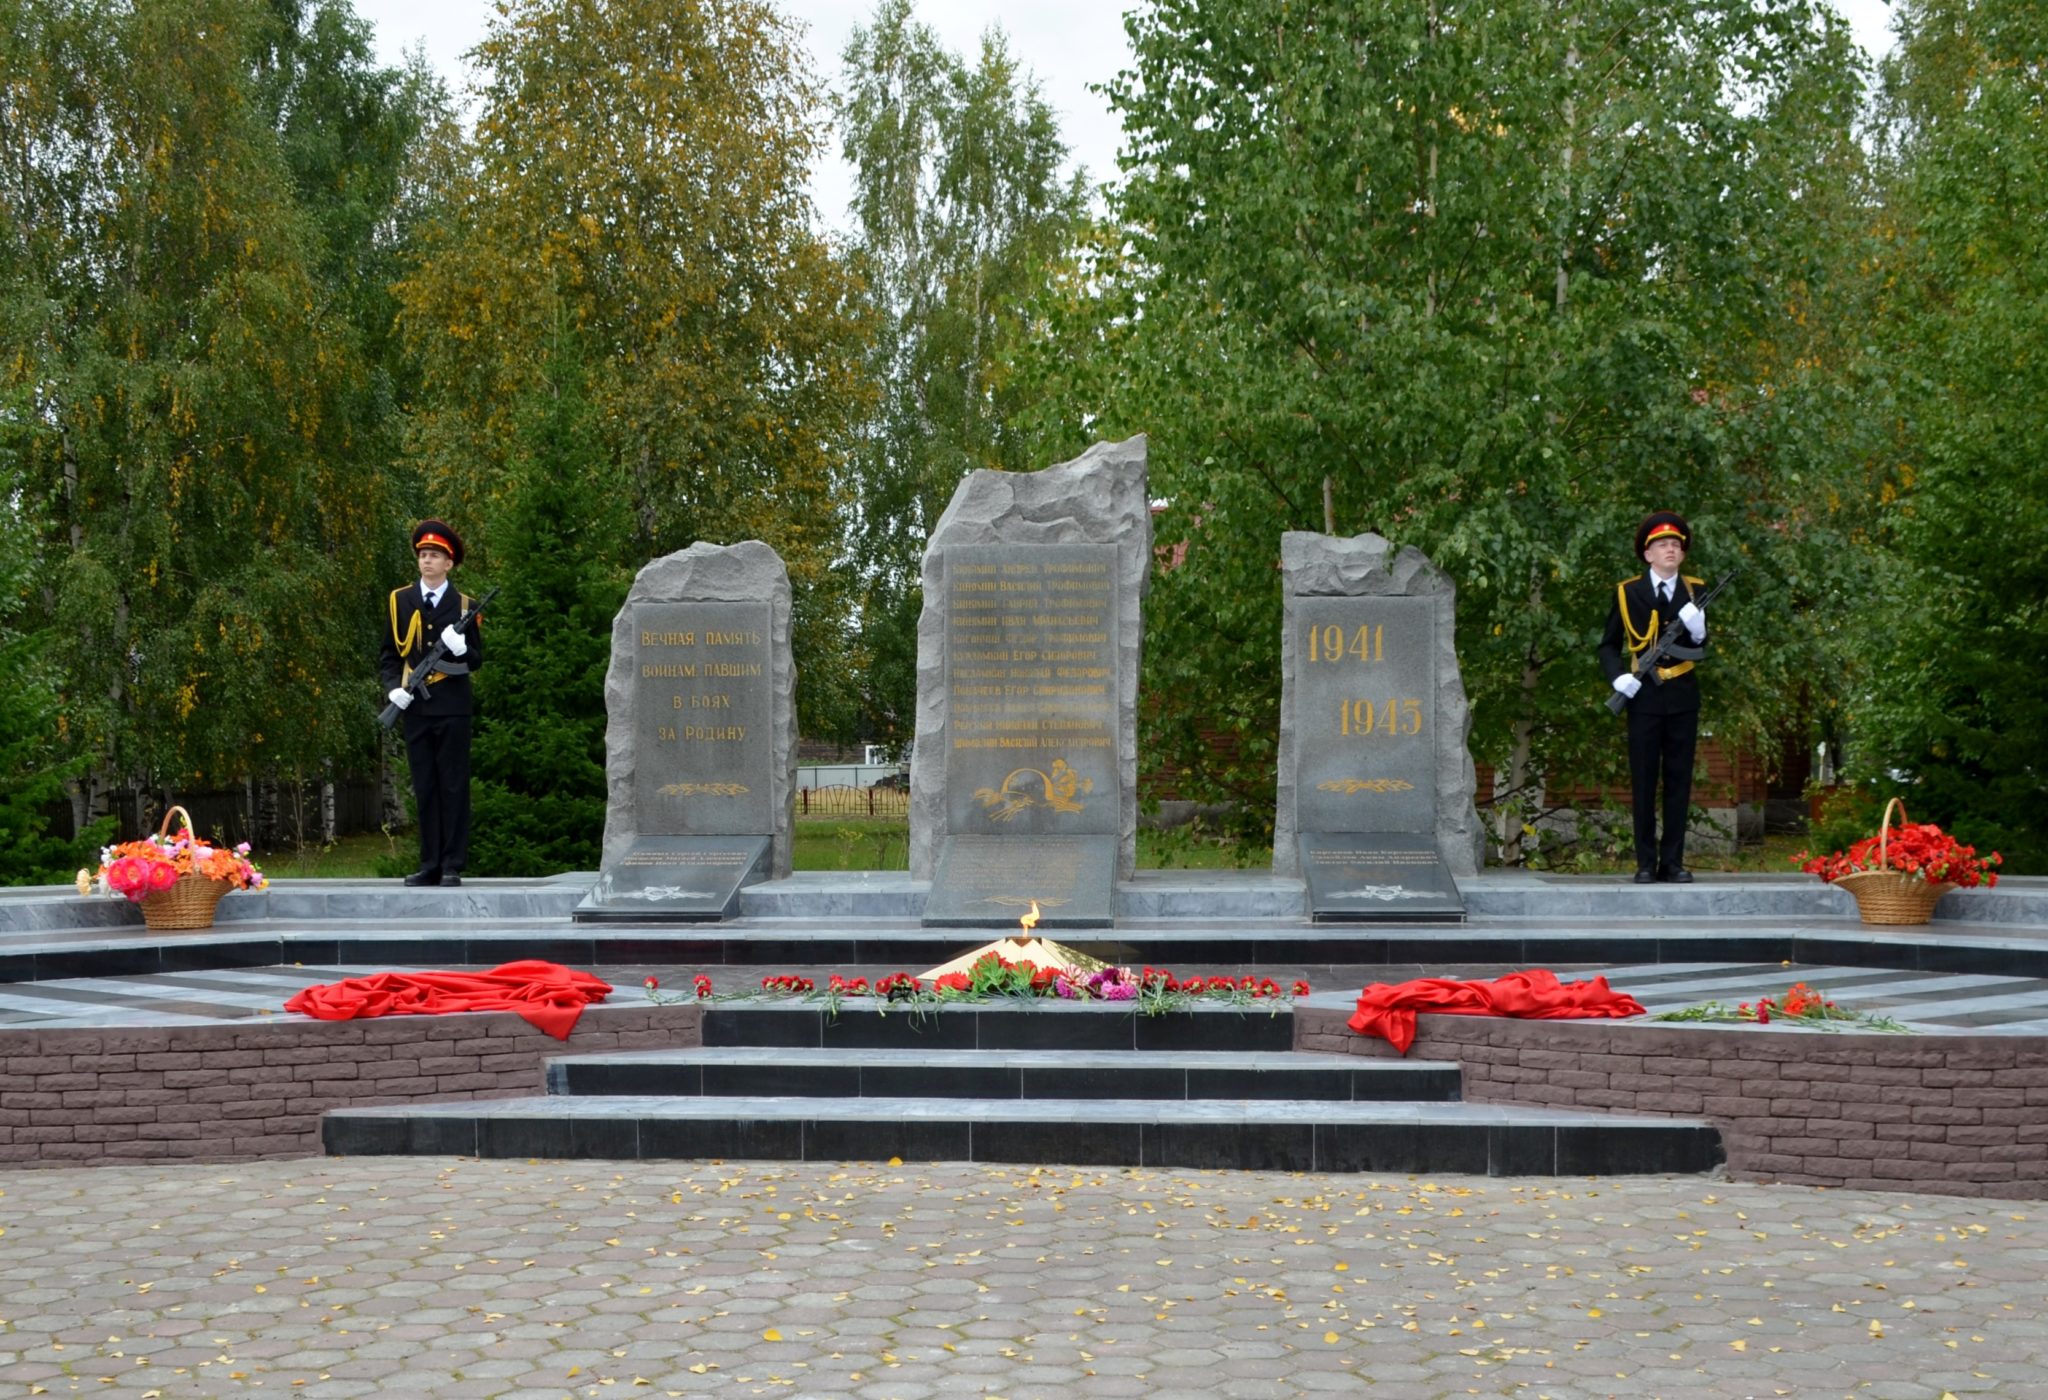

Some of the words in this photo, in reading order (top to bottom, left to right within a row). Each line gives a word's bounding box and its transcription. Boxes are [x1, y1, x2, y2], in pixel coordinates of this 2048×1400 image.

[641, 631, 695, 646] ВЕЧНАЯ
[706, 631, 761, 646] ПАМЯТЬ
[1309, 624, 1385, 662] 1941
[1013, 650, 1037, 661] ЕГОР
[641, 664, 696, 678] ВОИНАМ
[704, 663, 761, 677] ПАВШИМ
[673, 695, 682, 709] В
[691, 695, 731, 708] БОЯХ
[1340, 697, 1424, 737] 1945
[658, 726, 676, 741] ЗА
[685, 725, 747, 741] РОДИНУ
